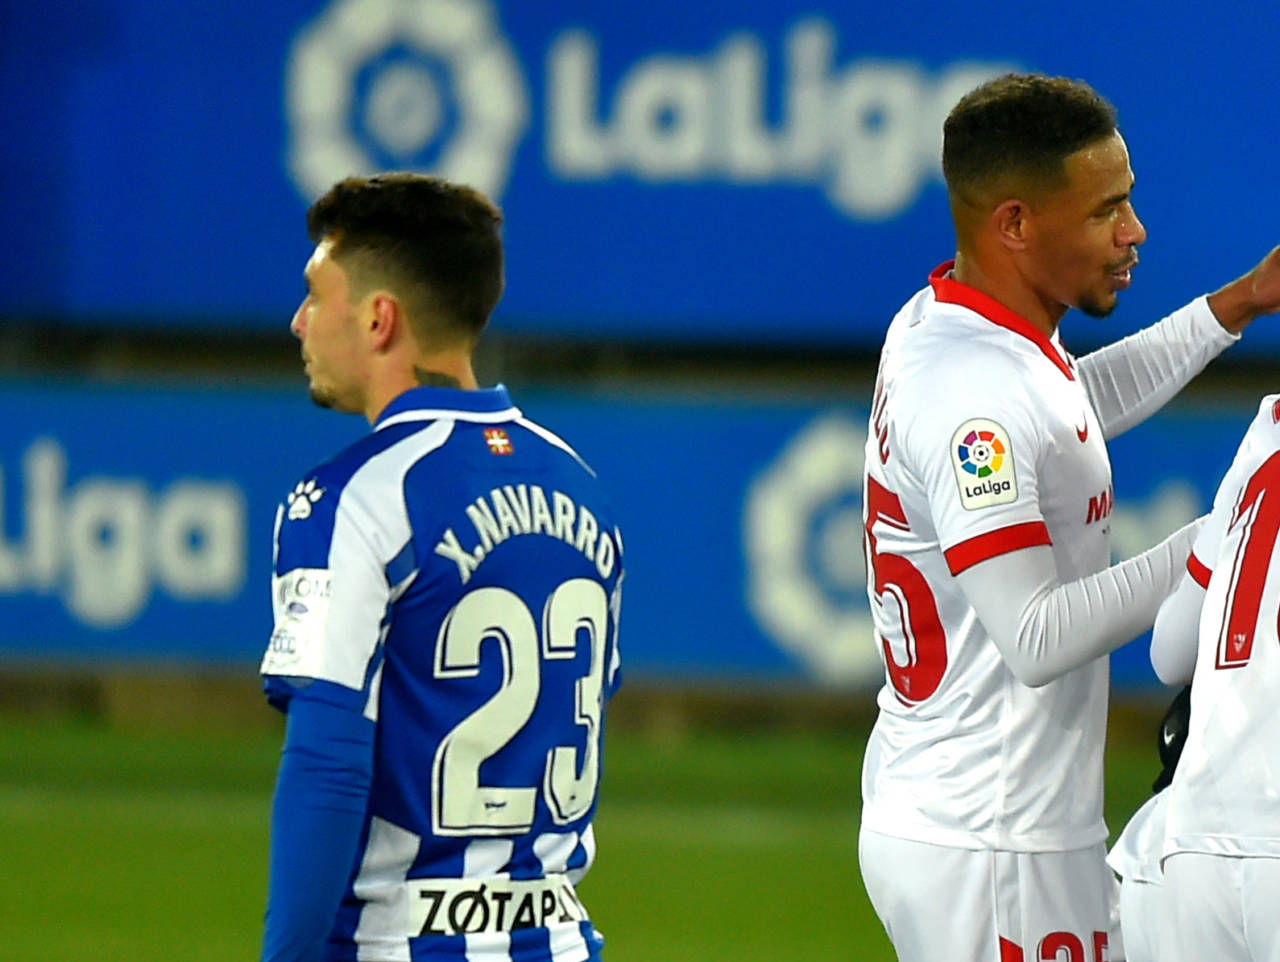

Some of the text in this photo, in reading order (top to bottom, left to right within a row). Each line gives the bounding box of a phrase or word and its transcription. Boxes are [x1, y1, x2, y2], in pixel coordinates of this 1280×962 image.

[0, 436, 246, 628] iga
[434, 483, 615, 582] X.NAVARRO
[965, 480, 1011, 498] LaLiga
[433, 578, 610, 836] 23
